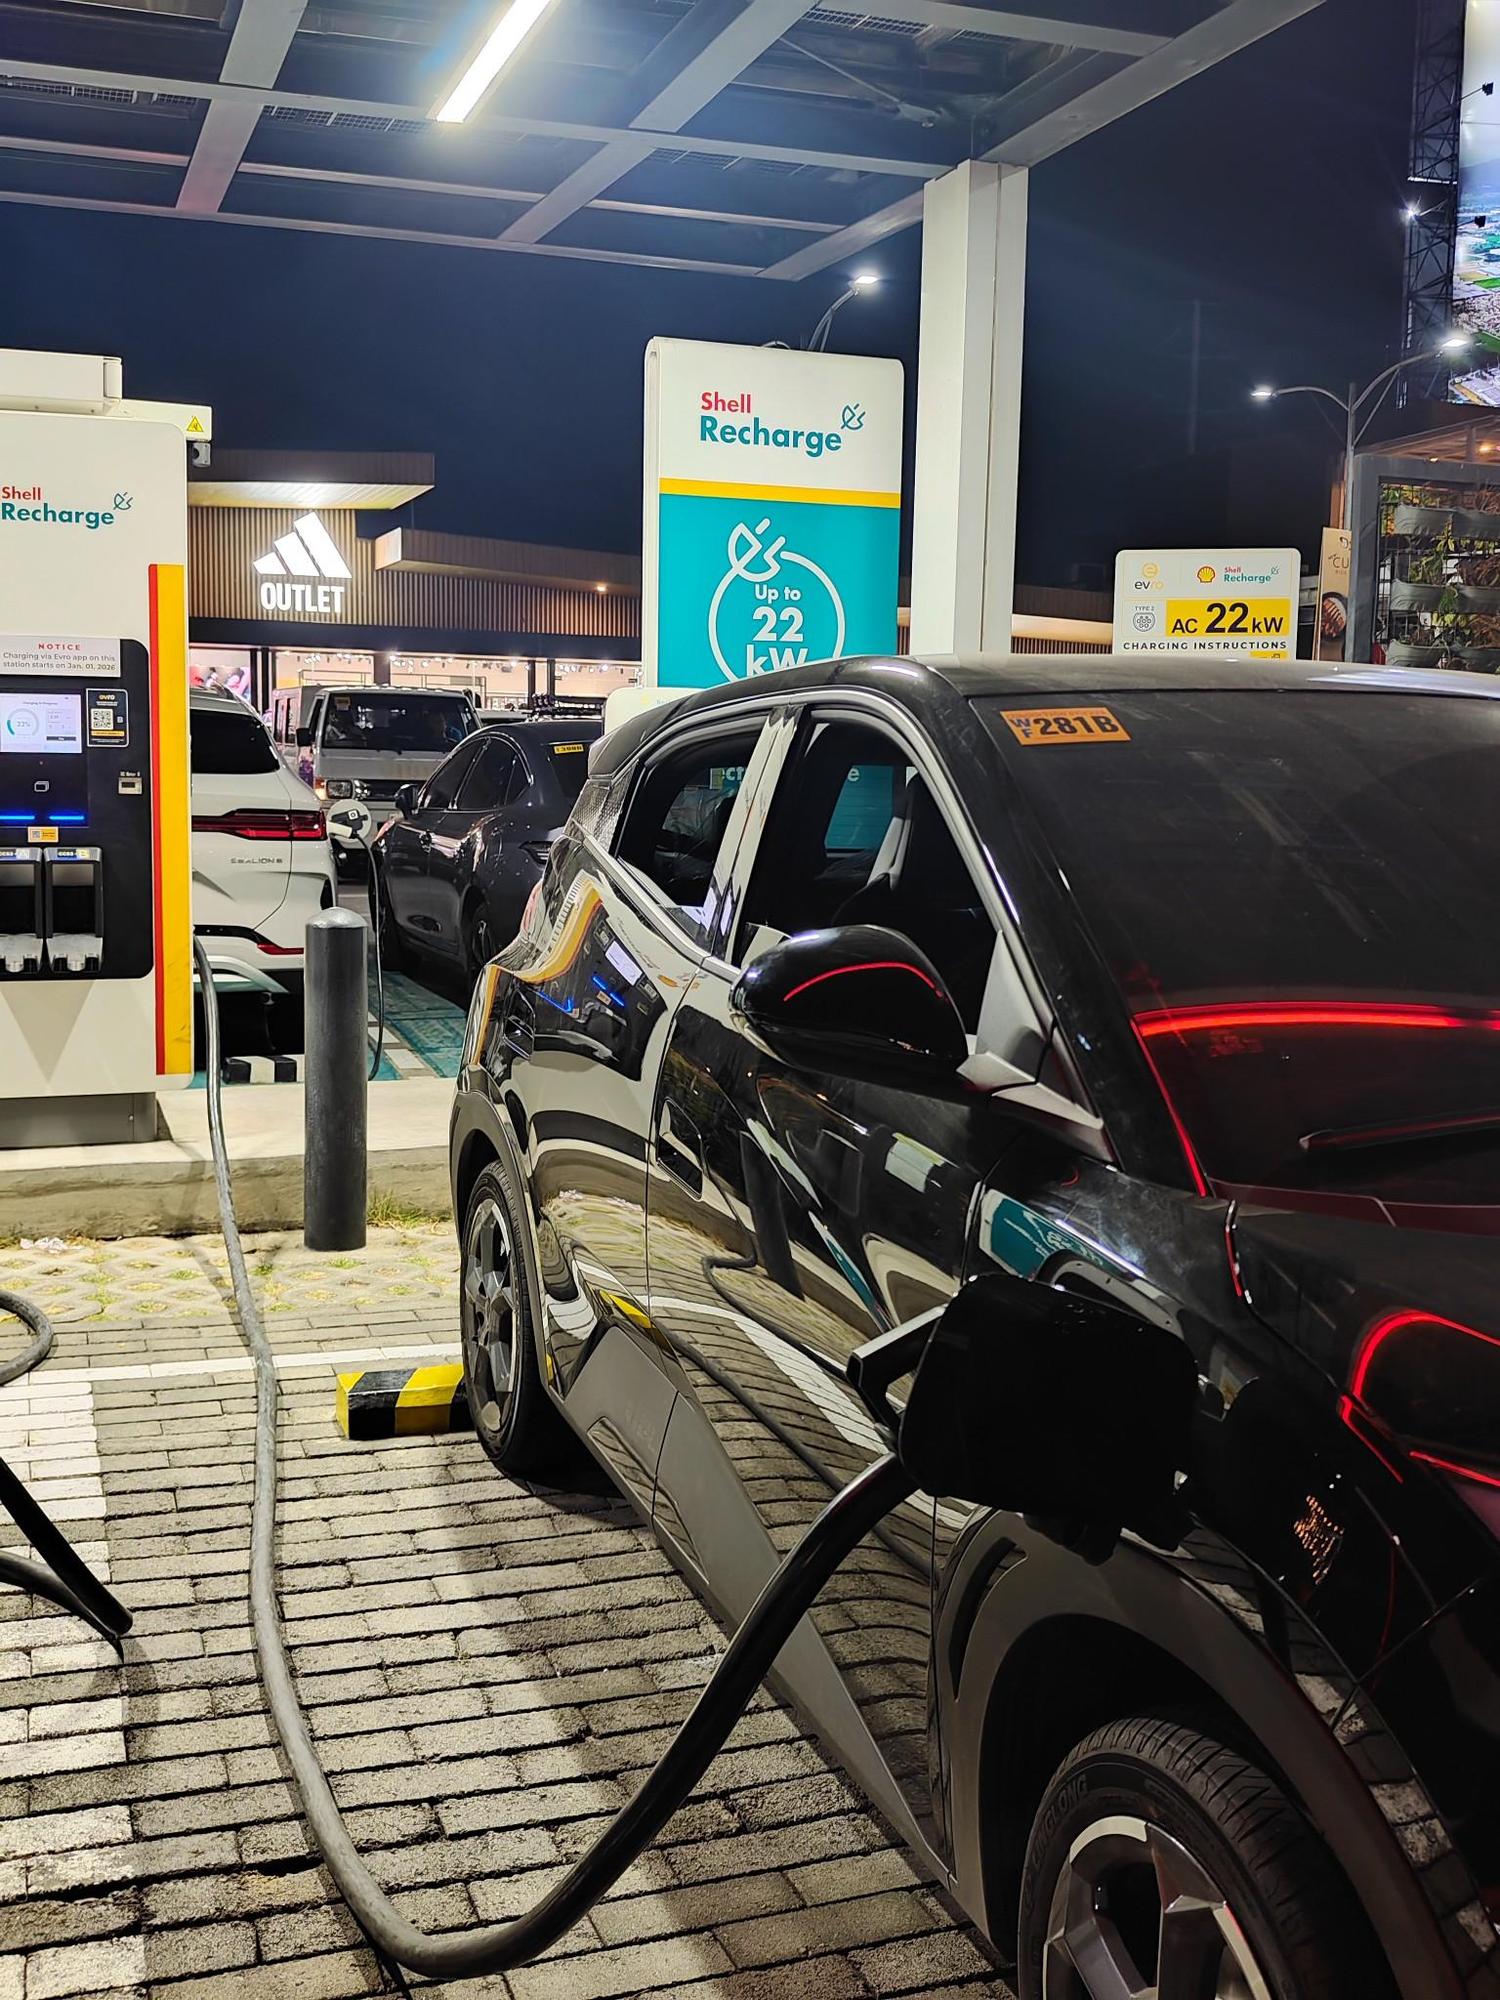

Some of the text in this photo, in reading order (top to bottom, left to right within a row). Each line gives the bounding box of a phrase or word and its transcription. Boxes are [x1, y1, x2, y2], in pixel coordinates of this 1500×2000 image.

[700, 392, 752, 414] Shell
[700, 415, 842, 458] Recharge
[1, 486, 42, 501] Shell
[1, 502, 115, 529] Recharge
[1224, 566, 1242, 574] Shell
[1224, 574, 1271, 584] Recharge
[259, 582, 345, 614] OUTLET
[754, 583, 802, 602] Up to
[752, 606, 804, 643] 22
[1171, 602, 1284, 634] AC 22 kW
[38, 643, 81, 652] NOTICE
[1123, 641, 1287, 651] CHARGING INSTRUCTIONS
[3, 652, 39, 661] Charging
[40, 653, 52, 661] via
[54, 653, 71, 661] Evro
[3, 661, 30, 669] station
[32, 661, 54, 669] starts
[85, 663, 96, 671] 01,
[746, 643, 808, 678] kW
